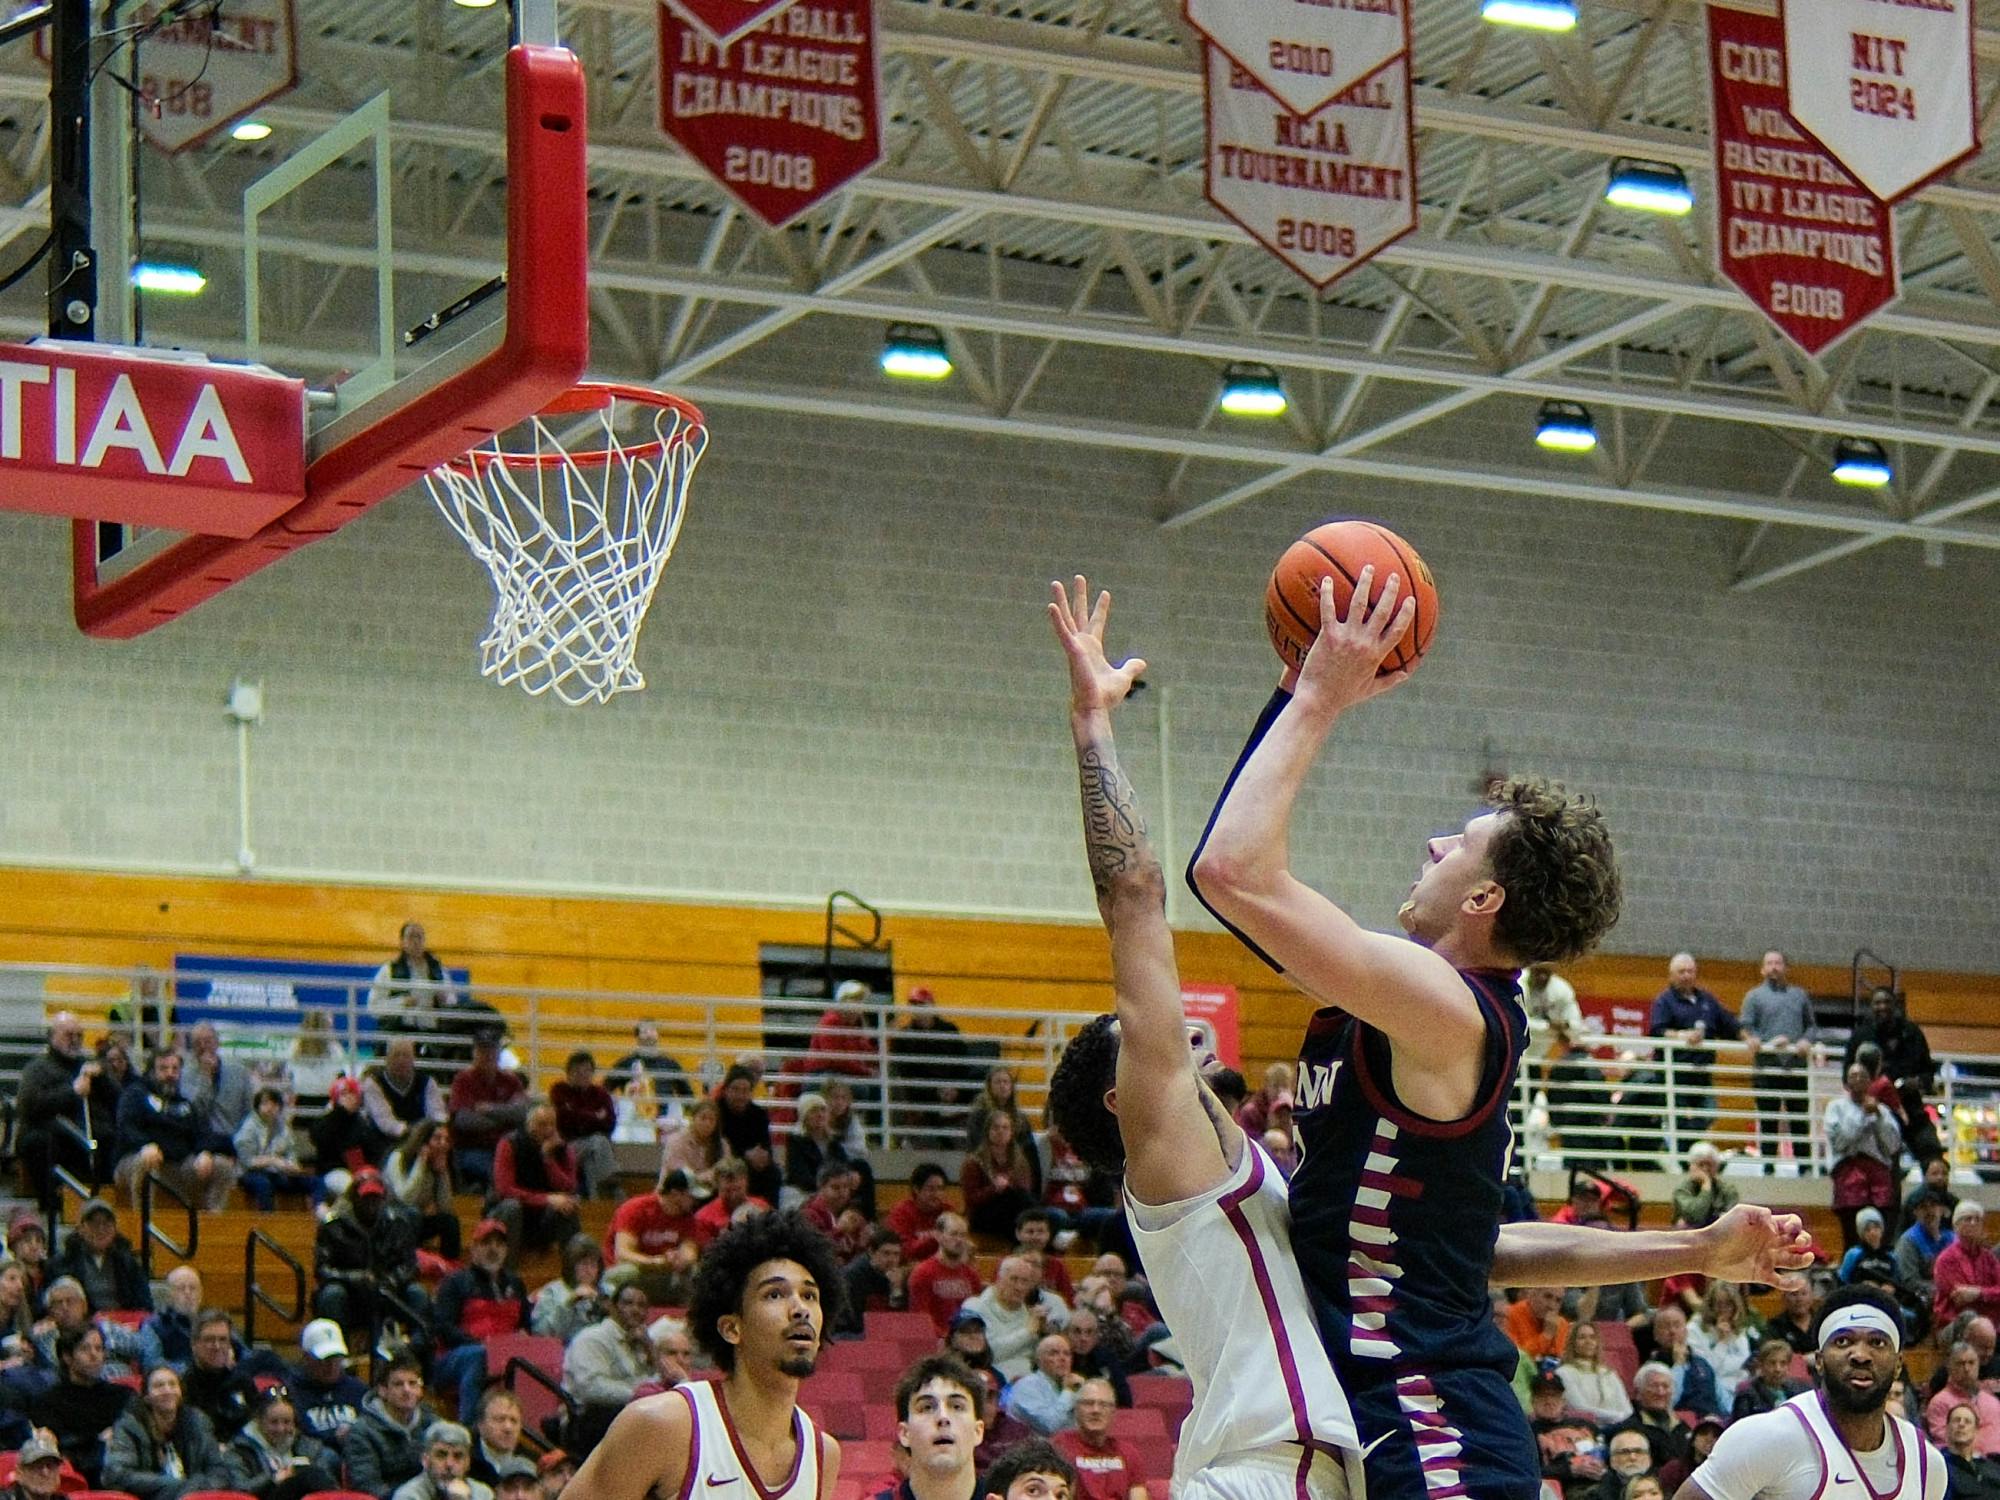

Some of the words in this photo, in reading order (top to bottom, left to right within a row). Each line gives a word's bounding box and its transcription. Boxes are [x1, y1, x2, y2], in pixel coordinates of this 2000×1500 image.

[743, 41, 858, 86] LEAGUE
[1270, 40, 1333, 77] 2010
[1851, 32, 1906, 76] NIT
[672, 72, 865, 141] CHAMPIONS
[1850, 78, 1916, 121] 2024
[725, 145, 816, 192] 2008
[1219, 144, 1403, 200] TOURNAMENT
[1732, 180, 1774, 213] IVY
[1782, 187, 1877, 227] LEAGUE
[1277, 218, 1356, 258] 2008
[1729, 217, 1884, 277] CHAMPIONS
[1771, 281, 1844, 321] 2008
[0, 361, 254, 484] TIAA
[1294, 1060, 1344, 1110] NN
